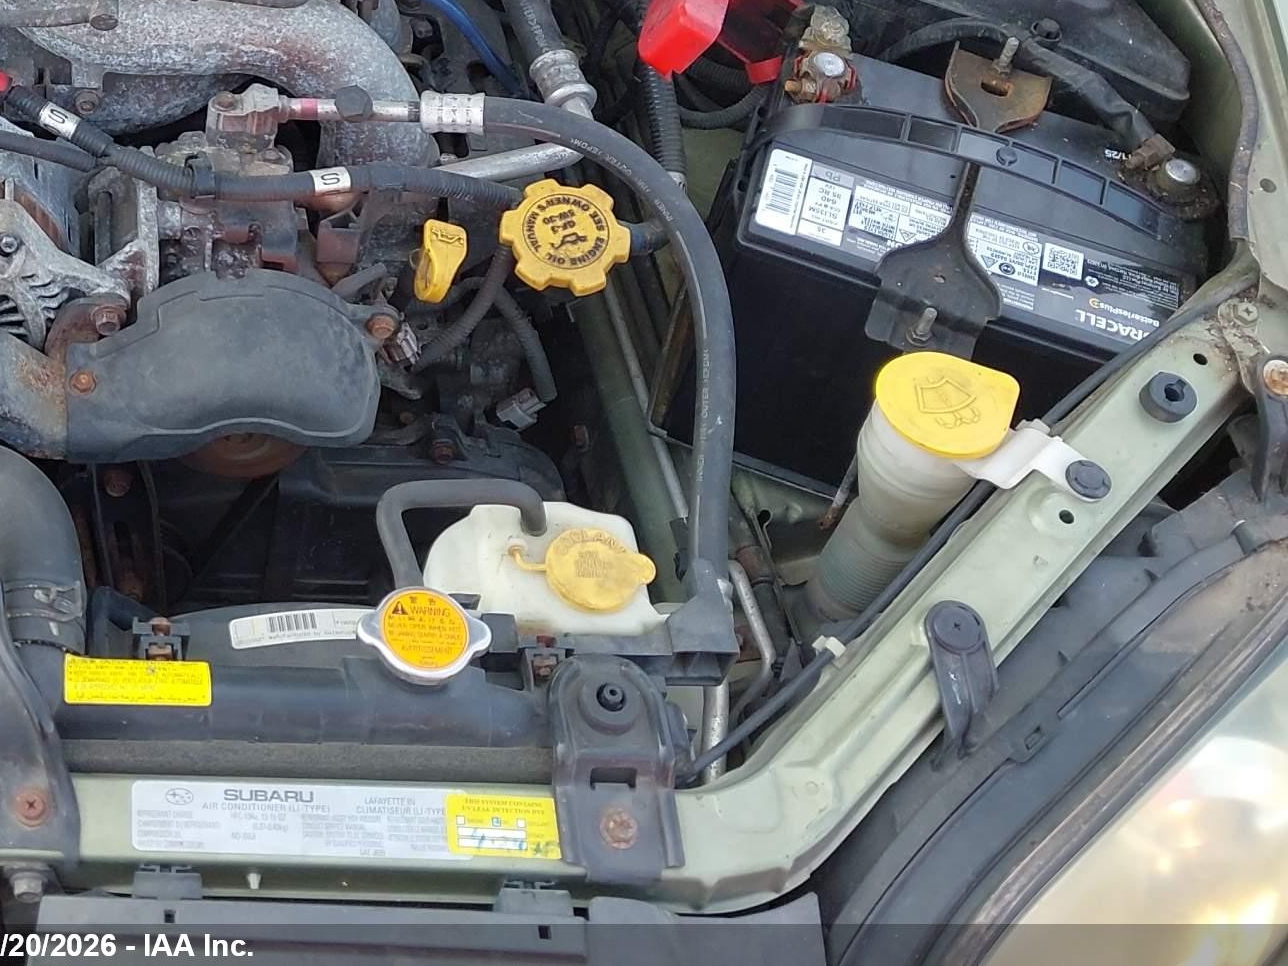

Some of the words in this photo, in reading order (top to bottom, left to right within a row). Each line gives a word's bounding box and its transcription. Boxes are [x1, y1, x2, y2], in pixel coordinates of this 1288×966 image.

[320, 172, 340, 185] S
[824, 170, 842, 183] Pb
[588, 211, 606, 233] SEE
[524, 211, 543, 253] MANUAL
[570, 237, 606, 267] ENGINE
[545, 252, 566, 266] OIL
[410, 606, 451, 617] WARNING
[223, 788, 314, 803] SUBARU
[364, 796, 404, 806] LAFAYETTE
[405, 798, 416, 806] IN
[202, 802, 218, 811] AIR
[220, 802, 287, 812] CONDITIONER
[356, 806, 411, 815] CLIMATISEUR
